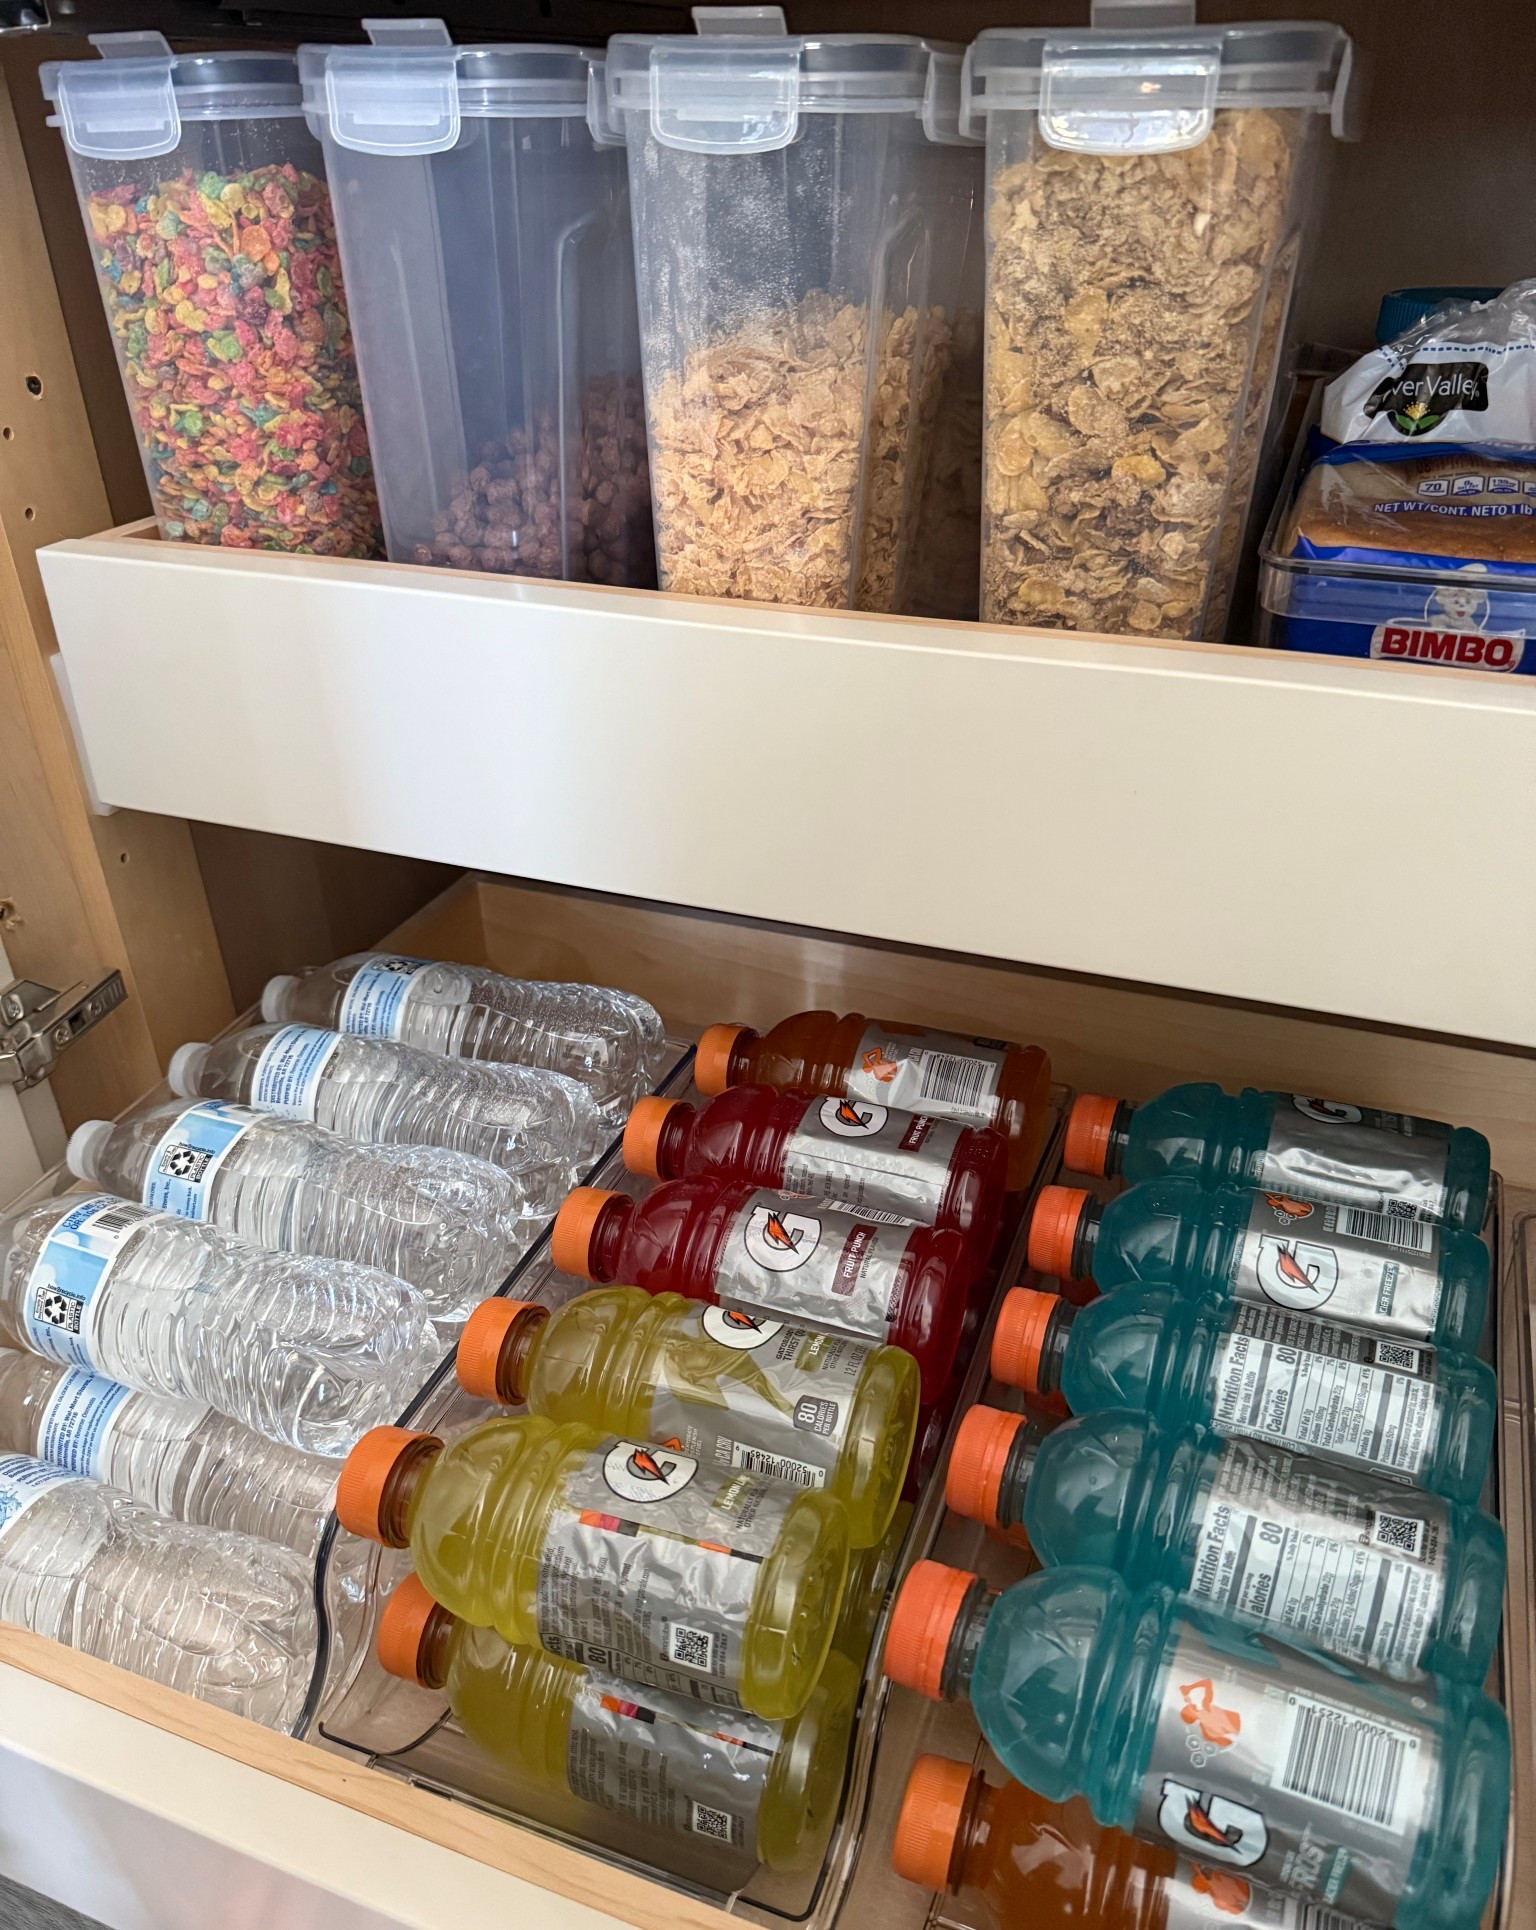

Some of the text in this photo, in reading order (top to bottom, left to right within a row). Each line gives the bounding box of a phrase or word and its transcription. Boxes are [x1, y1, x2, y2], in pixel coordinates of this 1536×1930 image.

[1427, 374, 1476, 397] Valley
[1425, 483, 1441, 491] 70
[1375, 503, 1400, 512] NET
[1404, 502, 1466, 515] WT/CONT.
[1472, 505, 1507, 516] NETO
[1383, 627, 1512, 666] BIMBO
[915, 1115, 928, 1131] PUNC
[191, 1154, 205, 1179] PLASTIC
[197, 1158, 209, 1179] BOTTLE
[162, 1190, 170, 1209] Stores,
[744, 1210, 822, 1272] G
[843, 1232, 865, 1277] FRUIT PUNCH
[860, 1255, 872, 1278] NATURAL
[1257, 1237, 1338, 1310] G
[1383, 1267, 1395, 1295] FREEZE
[48, 1285, 85, 1299] how2recycle.info
[68, 1302, 77, 1329] PLASTIC
[783, 1337, 799, 1360] THIRST
[809, 1335, 823, 1355] LEMON
[1219, 1337, 1249, 1419] Nutrition Facts
[1245, 1371, 1256, 1388] Bottle
[1362, 1368, 1370, 1379] 41%
[1242, 1393, 1251, 1403] size
[1267, 1347, 1296, 1432] Calories 80
[65, 1396, 79, 1421] Wal-Mart
[77, 1379, 92, 1395] Stores,
[1353, 1398, 1364, 1413] Added
[75, 1419, 85, 1438] Reverse
[82, 1397, 96, 1418] Osmosis
[798, 1403, 817, 1423] 80
[814, 1402, 827, 1431] CALORIES
[822, 1404, 835, 1434] PER BOTTLE
[1237, 1404, 1250, 1424] Serving
[1301, 1416, 1310, 1425] Fat
[1315, 1406, 1327, 1421] 160mg
[1322, 1385, 1345, 1446] Total Carbohydrate 22g
[66, 1430, 71, 1438] AR
[1298, 1426, 1308, 1440] Total
[1311, 1423, 1321, 1443] Sodium
[1338, 1417, 1348, 1433] Sugars
[1348, 1424, 1359, 1443] Includes
[1264, 1436, 1296, 1449] CONTAINS
[1335, 1433, 1344, 1444] Total
[1358, 1437, 1369, 1457] Protein
[62, 1438, 71, 1469] Bentonville,
[750, 1449, 775, 1465] 12485
[605, 1444, 696, 1503] G
[780, 1458, 808, 1474] 52000
[722, 1484, 740, 1509] LEMON
[736, 1497, 754, 1529] NATURALLY
[744, 1508, 757, 1528] OTHER
[1207, 1507, 1230, 1543] Facts
[1260, 1522, 1282, 1544] 80
[1221, 1575, 1229, 1586] size
[1286, 1606, 1295, 1616] Fat
[1313, 1584, 1329, 1625] Carbohydrate
[588, 1647, 606, 1663] 80
[1310, 1705, 1349, 1727] 12251
[1354, 1720, 1395, 1742] 52000
[1409, 1740, 1416, 1748] 0
[1160, 1779, 1267, 1862] G
